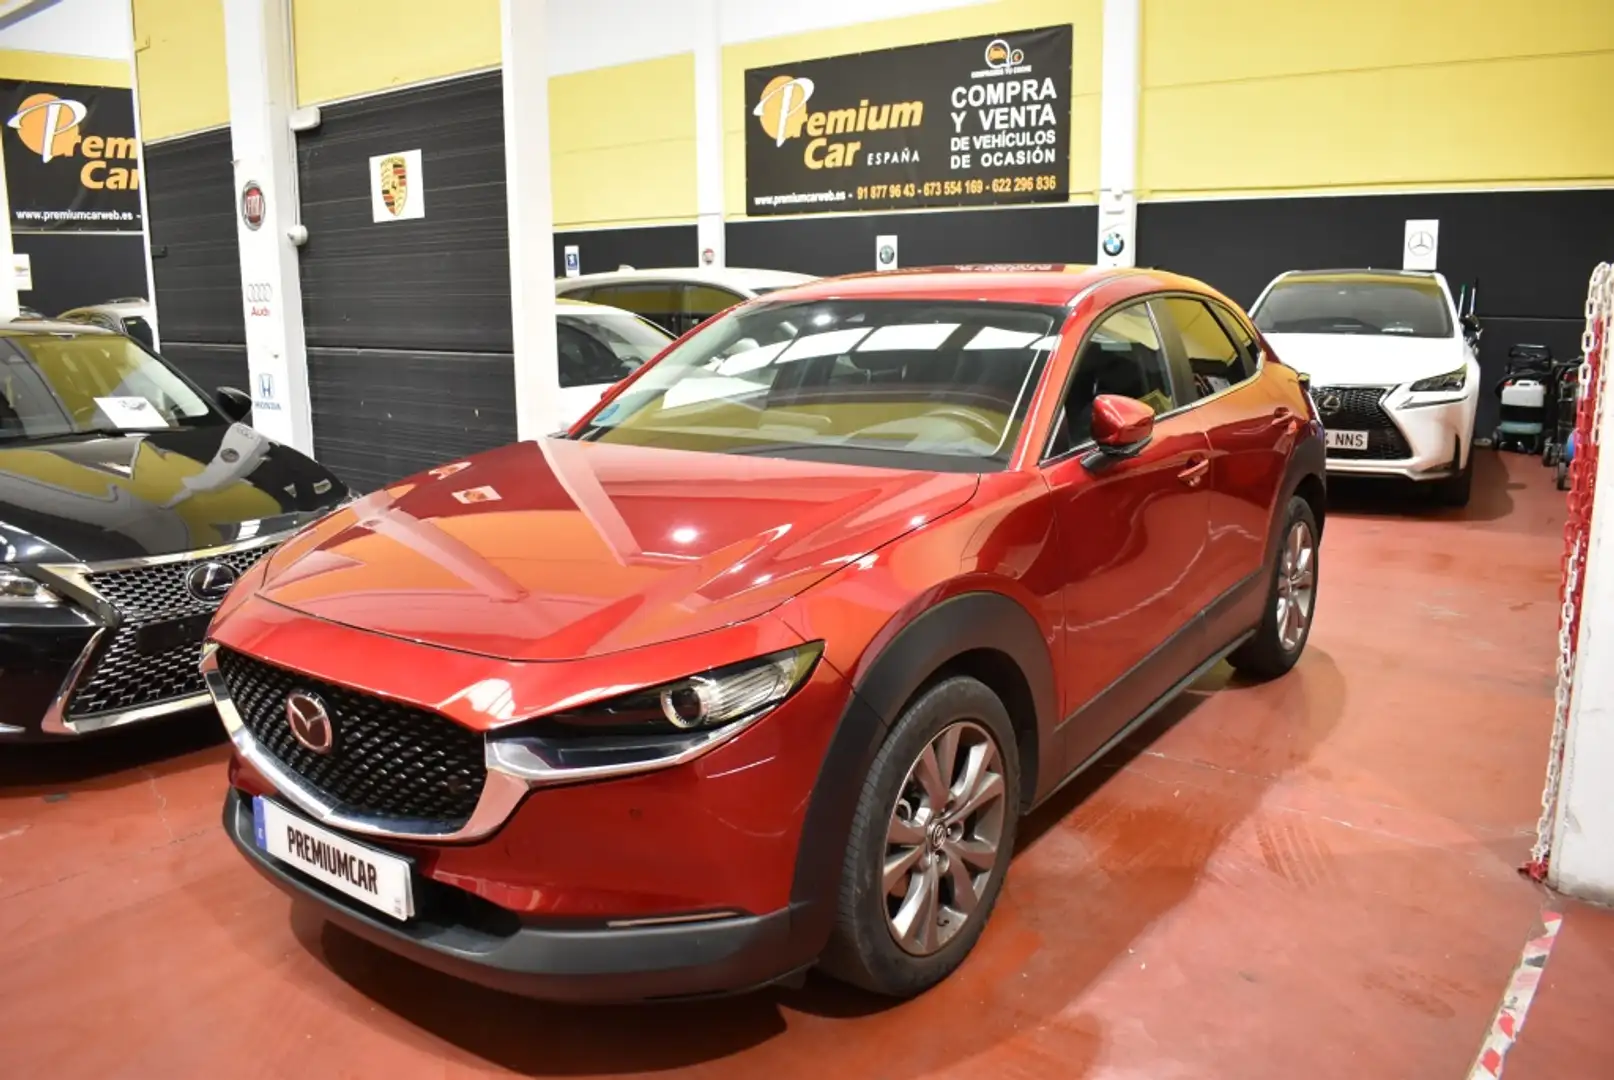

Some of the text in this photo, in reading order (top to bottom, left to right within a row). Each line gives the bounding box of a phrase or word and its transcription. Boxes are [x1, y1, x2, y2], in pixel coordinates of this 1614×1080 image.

[951, 77, 1057, 108] COMPRA
[753, 77, 923, 148] Premium
[951, 103, 1057, 133] Y VENTA
[804, 138, 920, 170] Car ESPAÑA
[950, 129, 1056, 151] DE VEHÍCULOS
[950, 146, 1056, 170] DE OCASIÓN
[754, 190, 846, 207] www.premiumcarweb.es
[857, 186, 868, 200] 91
[870, 184, 887, 199] 877
[903, 183, 915, 197] 43
[944, 180, 962, 195] 554
[992, 177, 1012, 192] 622
[1014, 176, 1034, 191] 296
[1036, 175, 1057, 190] 836
[16, 208, 133, 221] www.premiumcarweb.es
[1335, 432, 1364, 447] NNS
[287, 826, 379, 895] PREMIUMCAR
